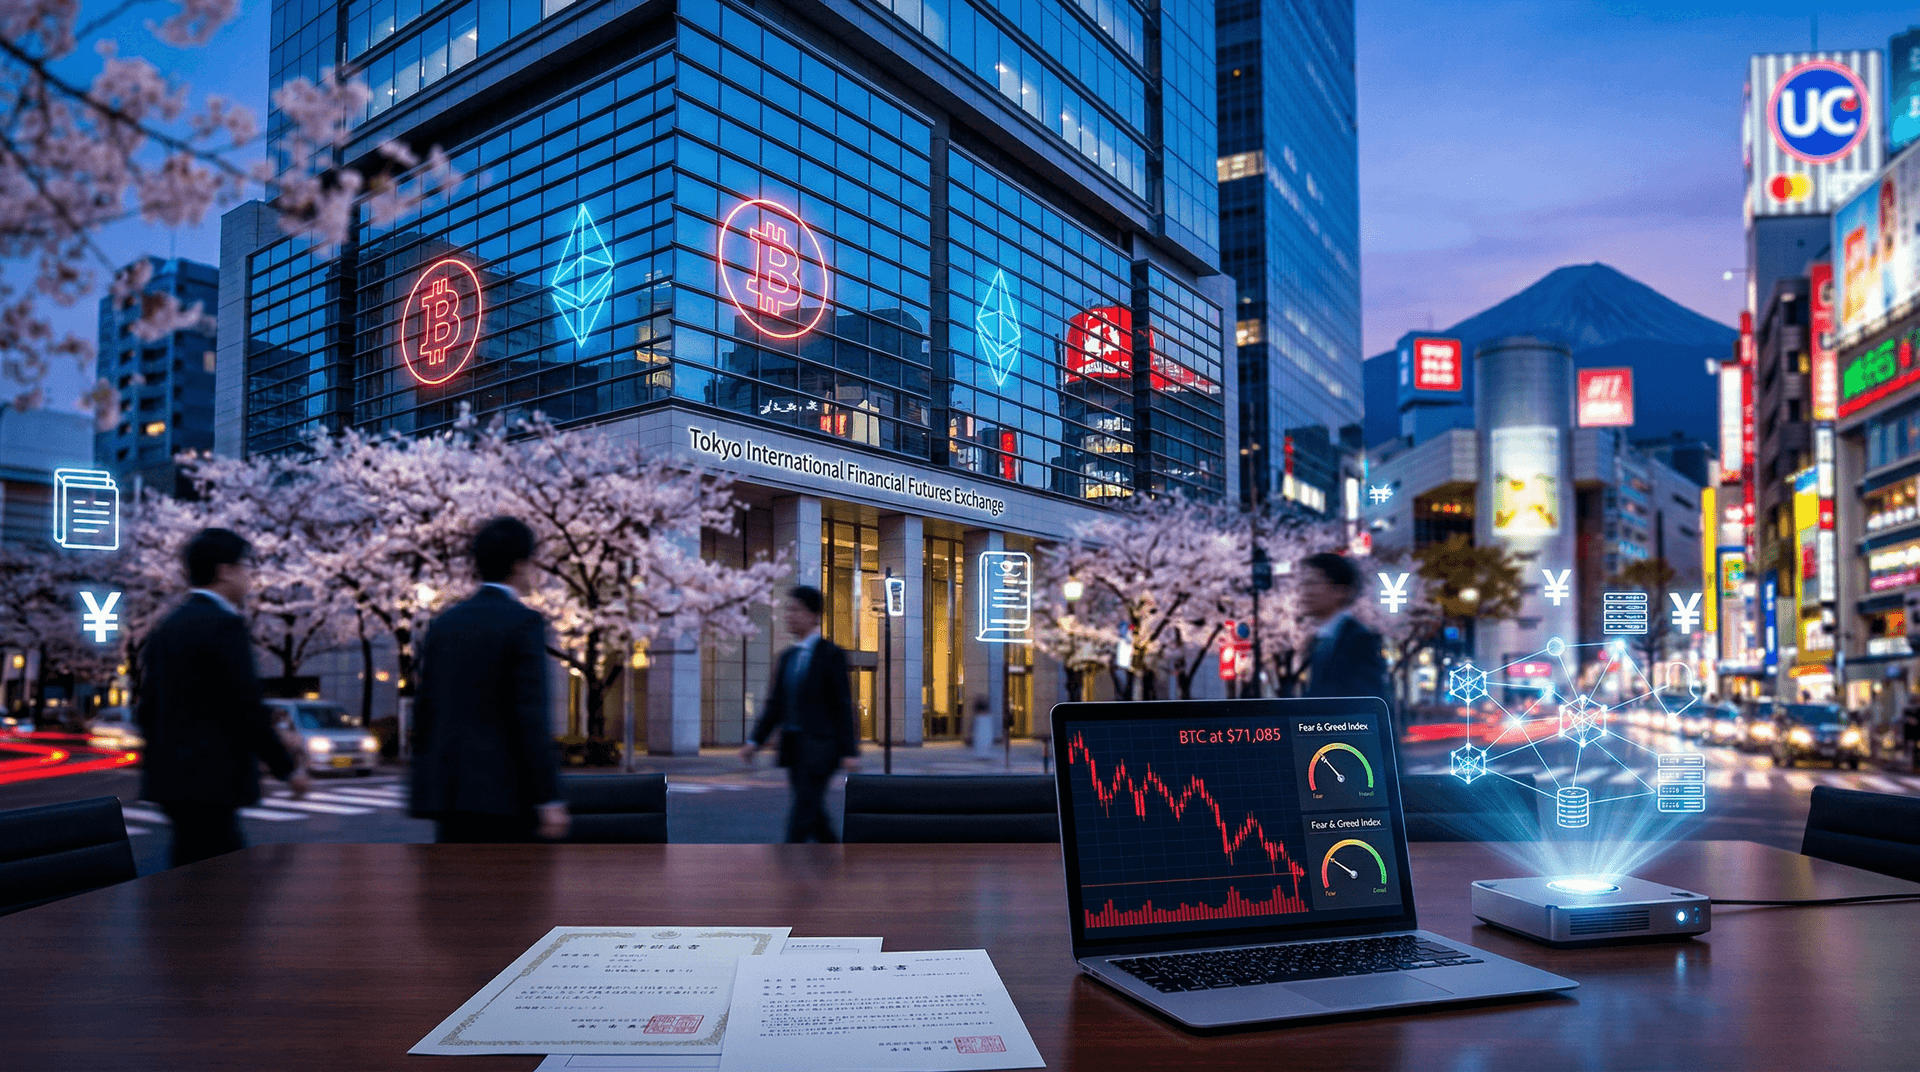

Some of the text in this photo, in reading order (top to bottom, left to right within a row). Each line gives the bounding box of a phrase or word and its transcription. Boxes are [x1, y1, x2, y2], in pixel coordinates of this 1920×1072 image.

[1781, 87, 1857, 136] UC
[690, 428, 1004, 516] Tokyo International Financial Futures Exchange
[1298, 721, 1369, 732] Fear & Greed Index
[1179, 727, 1281, 744] BTC at $71,085
[1311, 817, 1381, 829] Fear & Greed Index
